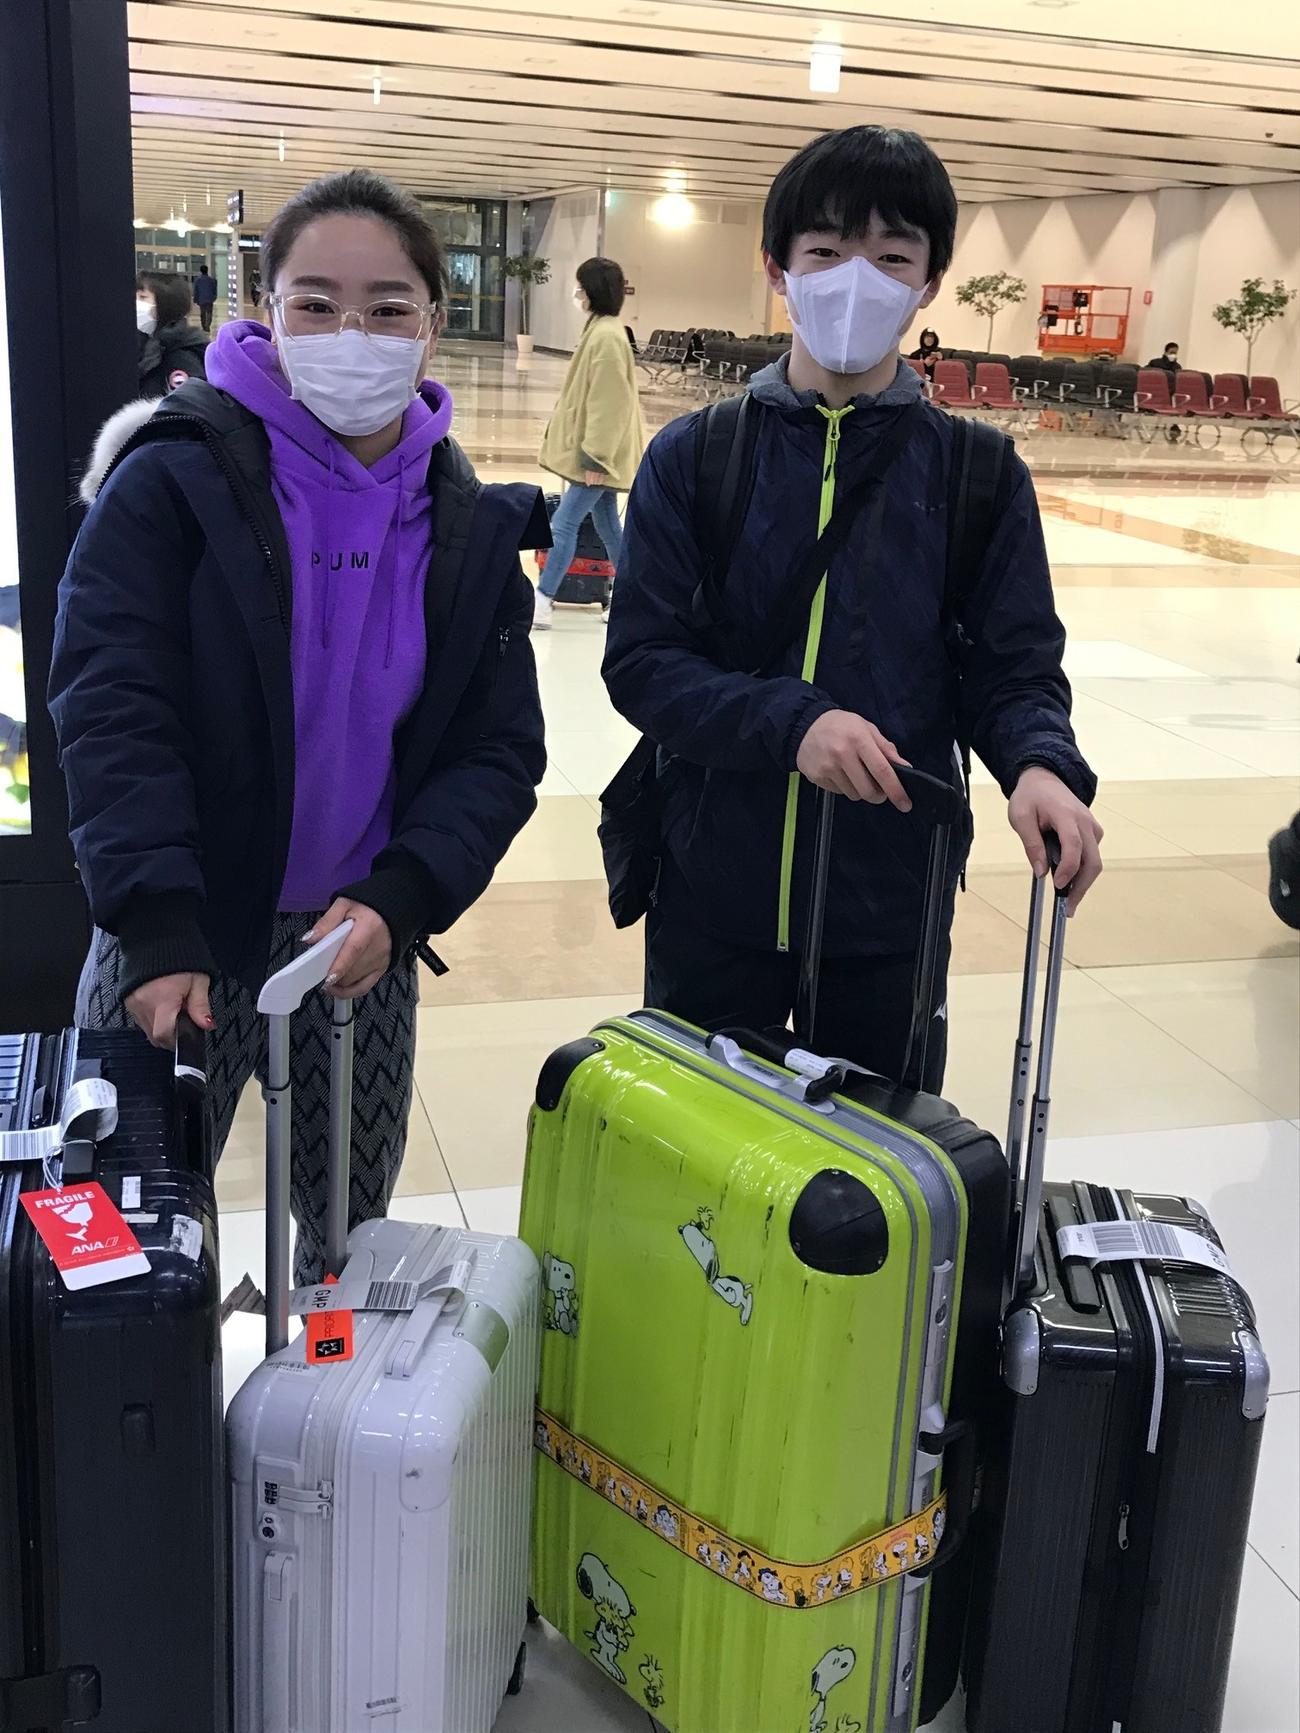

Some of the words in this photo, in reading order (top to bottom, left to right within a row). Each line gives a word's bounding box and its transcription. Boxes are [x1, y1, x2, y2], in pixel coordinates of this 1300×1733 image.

[35, 1191, 95, 1208] FRAGILE
[72, 1241, 104, 1255] ANA
[314, 1288, 331, 1309] GMP
